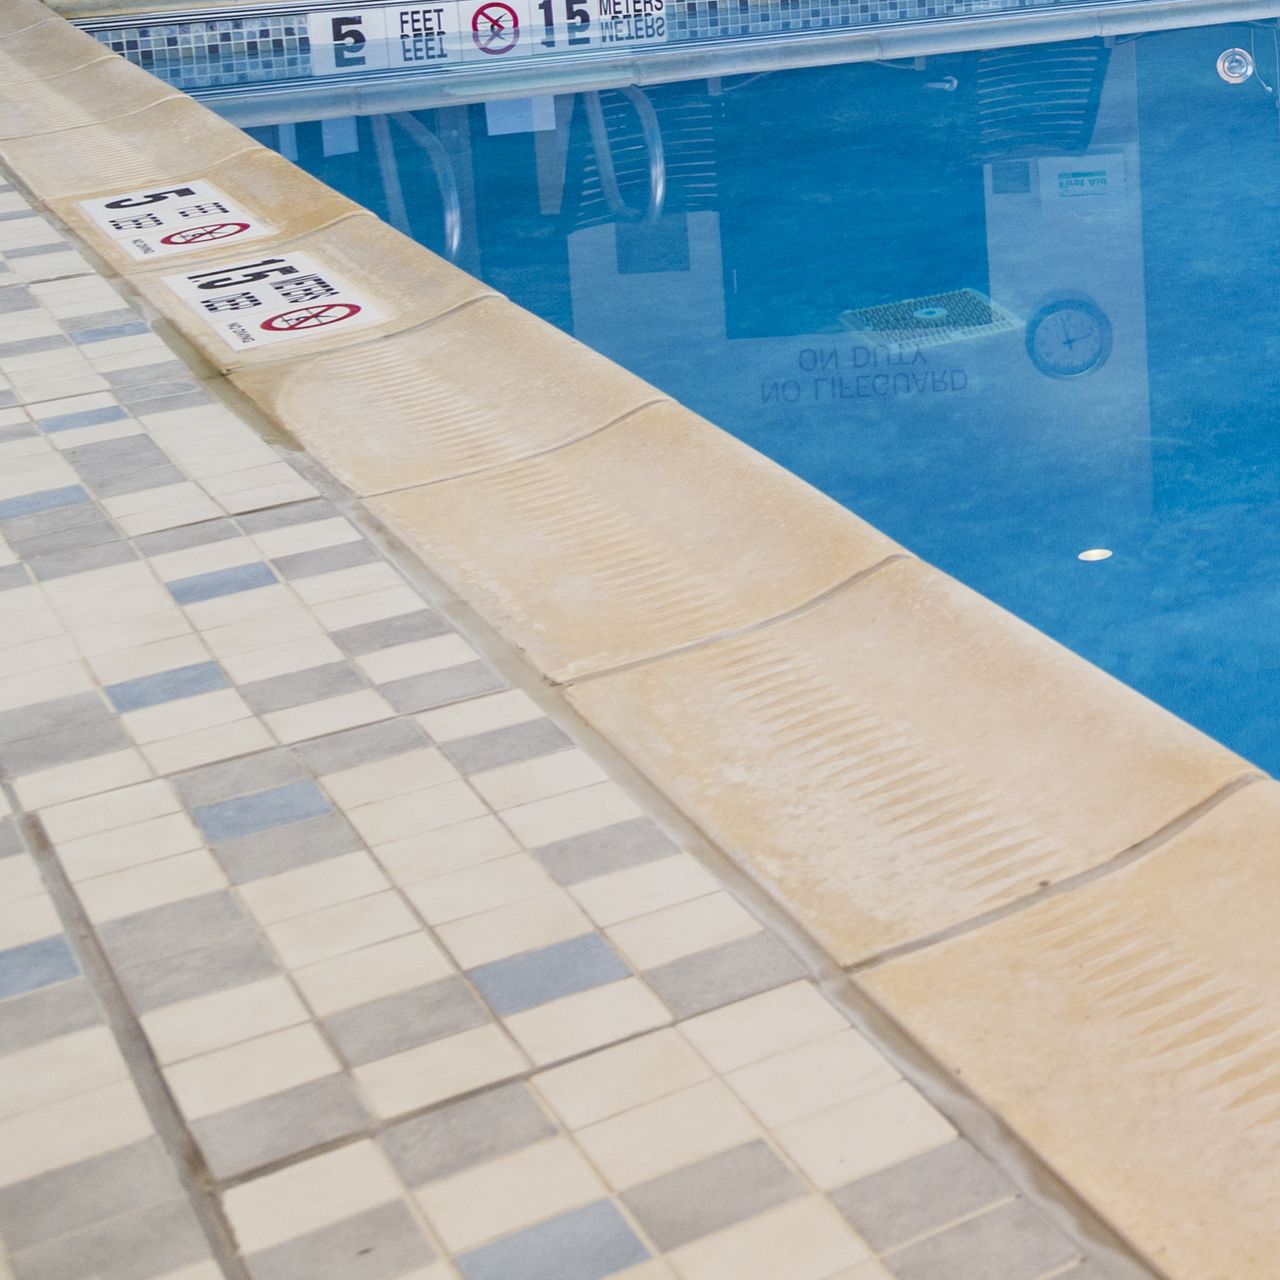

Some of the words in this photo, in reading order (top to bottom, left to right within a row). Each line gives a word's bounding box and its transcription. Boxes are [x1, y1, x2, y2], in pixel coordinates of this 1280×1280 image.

[331, 15, 367, 68] 5
[400, 8, 444, 34] FEET
[104, 187, 196, 209] 5
